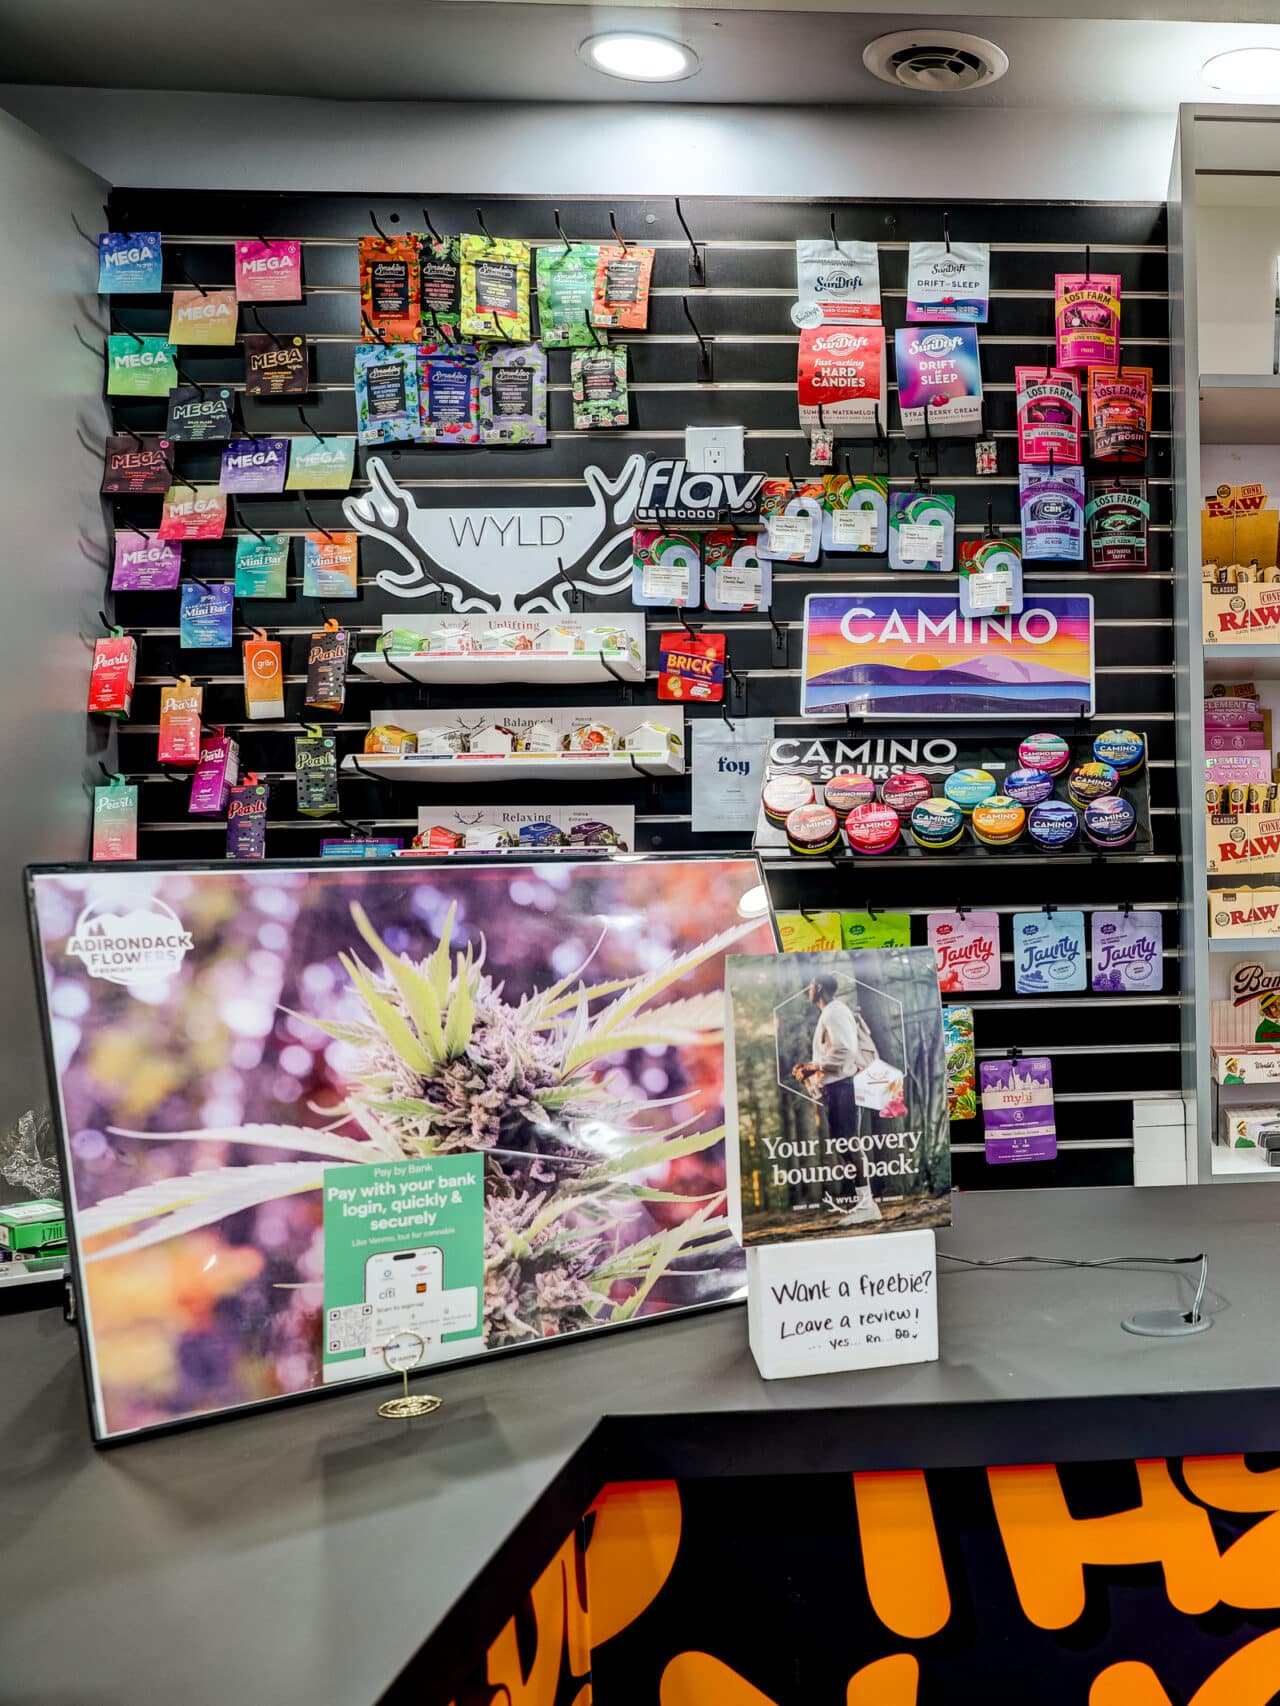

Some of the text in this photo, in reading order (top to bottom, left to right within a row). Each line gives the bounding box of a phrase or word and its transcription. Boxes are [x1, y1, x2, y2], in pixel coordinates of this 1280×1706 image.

[814, 275, 864, 292] SunDrift
[917, 280, 944, 288] DRIFT
[1064, 291, 1111, 305] LOST FARM
[812, 337, 869, 351] SunDrift
[909, 335, 963, 355] SunDrift
[115, 353, 167, 369] MEGA
[251, 348, 303, 371] MEGA
[814, 359, 865, 370] fast-acting
[920, 360, 956, 370] DRIFT
[822, 368, 856, 377] HARD
[921, 375, 958, 385] SLEEP
[812, 378, 865, 387] CANDIES
[1027, 387, 1073, 401] LOST FARM
[173, 400, 226, 420] MEGA
[904, 409, 952, 418] STRABERRY
[1097, 434, 1144, 449] LIVE ROSIN
[228, 451, 278, 471] MEGA
[295, 452, 346, 470] MEGA
[640, 459, 764, 510] flav
[1095, 495, 1140, 508] LOST FARM
[449, 515, 565, 547] WYLD
[237, 550, 286, 570] Mini Bar
[1212, 585, 1236, 593] CLASSIC
[840, 607, 1058, 644] CAMINO
[93, 653, 129, 670] Pearls
[309, 645, 345, 665] Pearls
[667, 654, 716, 675] BRICK
[769, 739, 957, 764] CAMINO
[717, 756, 751, 776] foy
[820, 765, 903, 780] SOURS
[229, 800, 266, 819] Pearls
[502, 812, 552, 823] Relaxing
[852, 820, 892, 830] CAMINO
[1261, 822, 1280, 832] CONE
[1209, 860, 1216, 868] 3
[1230, 904, 1279, 926] RAW
[70, 935, 190, 953] ADIRONDACK
[90, 950, 177, 966] FLOWERS
[937, 936, 995, 971] Jaunty
[1021, 936, 1080, 972] Jaunty
[1098, 936, 1157, 972] Jaunty
[762, 1131, 923, 1160] Your recovery
[374, 1163, 433, 1179] Pay by Bank
[772, 1154, 920, 1186] bounce back.
[328, 1173, 476, 1204] Pay with your bank
[343, 1190, 463, 1219] login, quickly &
[370, 1210, 437, 1231] securely
[352, 1237, 367, 1248] Like
[397, 1233, 411, 1242] but
[412, 1231, 422, 1240] for
[379, 1287, 396, 1301] citi
[771, 1270, 933, 1304] Want a freebie?
[780, 1316, 833, 1340] Leave
[840, 1314, 851, 1328] a
